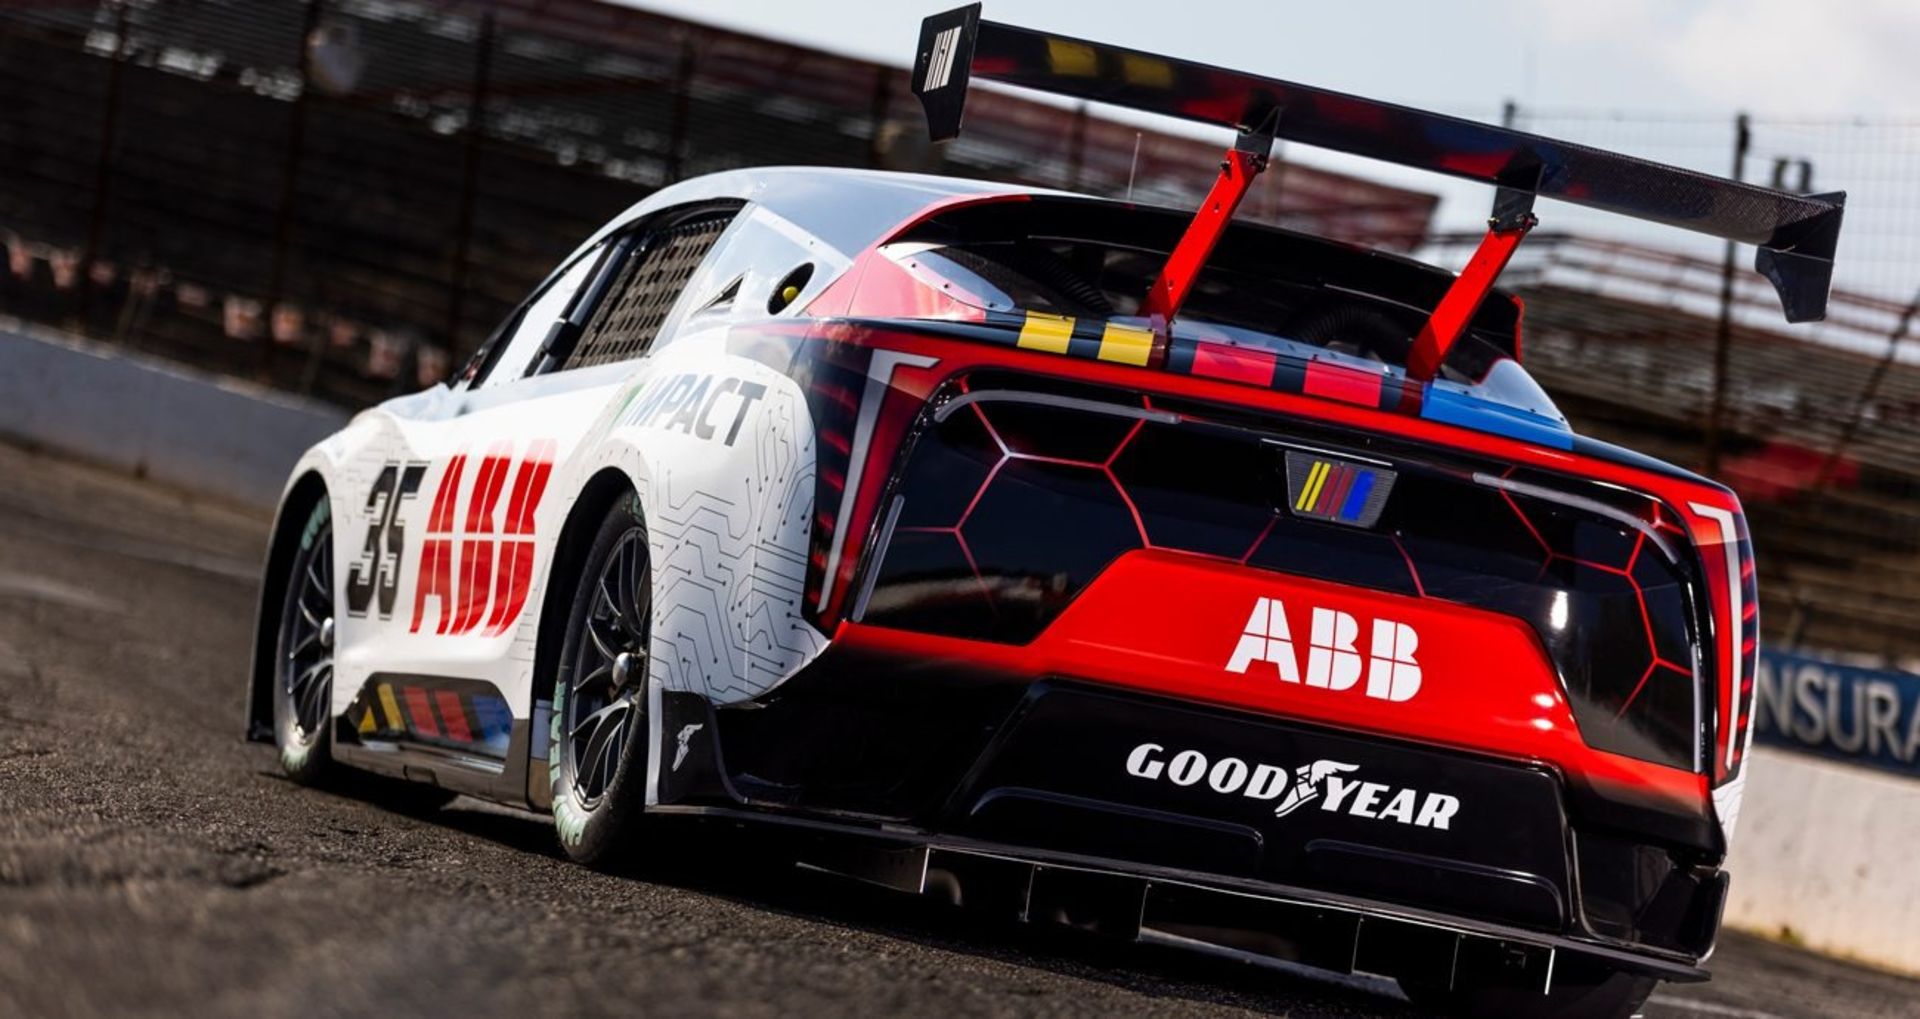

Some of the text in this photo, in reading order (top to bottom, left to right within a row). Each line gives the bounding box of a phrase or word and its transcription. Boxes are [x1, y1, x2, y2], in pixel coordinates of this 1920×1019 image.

[344, 460, 431, 621] 35
[408, 439, 559, 638] ABB
[1224, 596, 1423, 702] ABB
